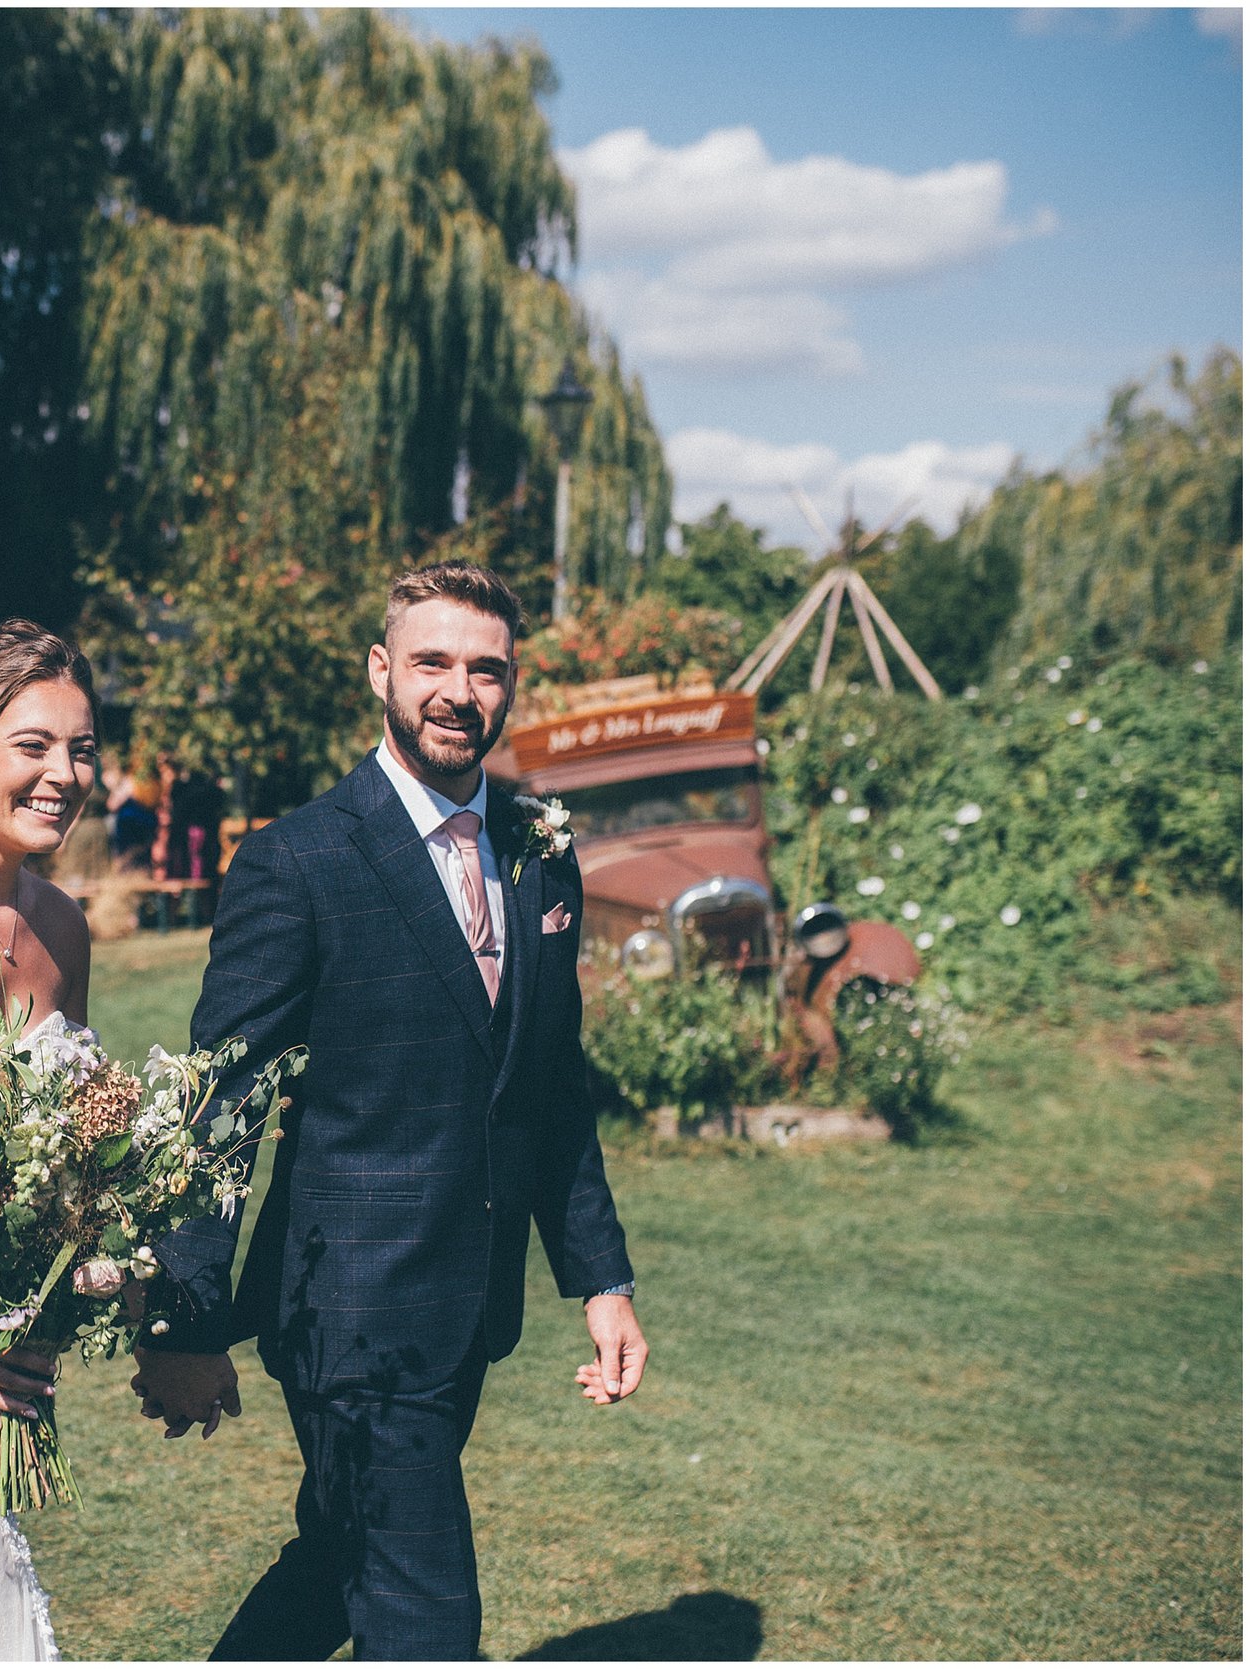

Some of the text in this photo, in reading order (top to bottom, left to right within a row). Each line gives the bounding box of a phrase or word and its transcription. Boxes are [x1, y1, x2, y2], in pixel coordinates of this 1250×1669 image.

[548, 726, 577, 753] Mr
[579, 719, 600, 746] &
[603, 714, 640, 741] Mrs
